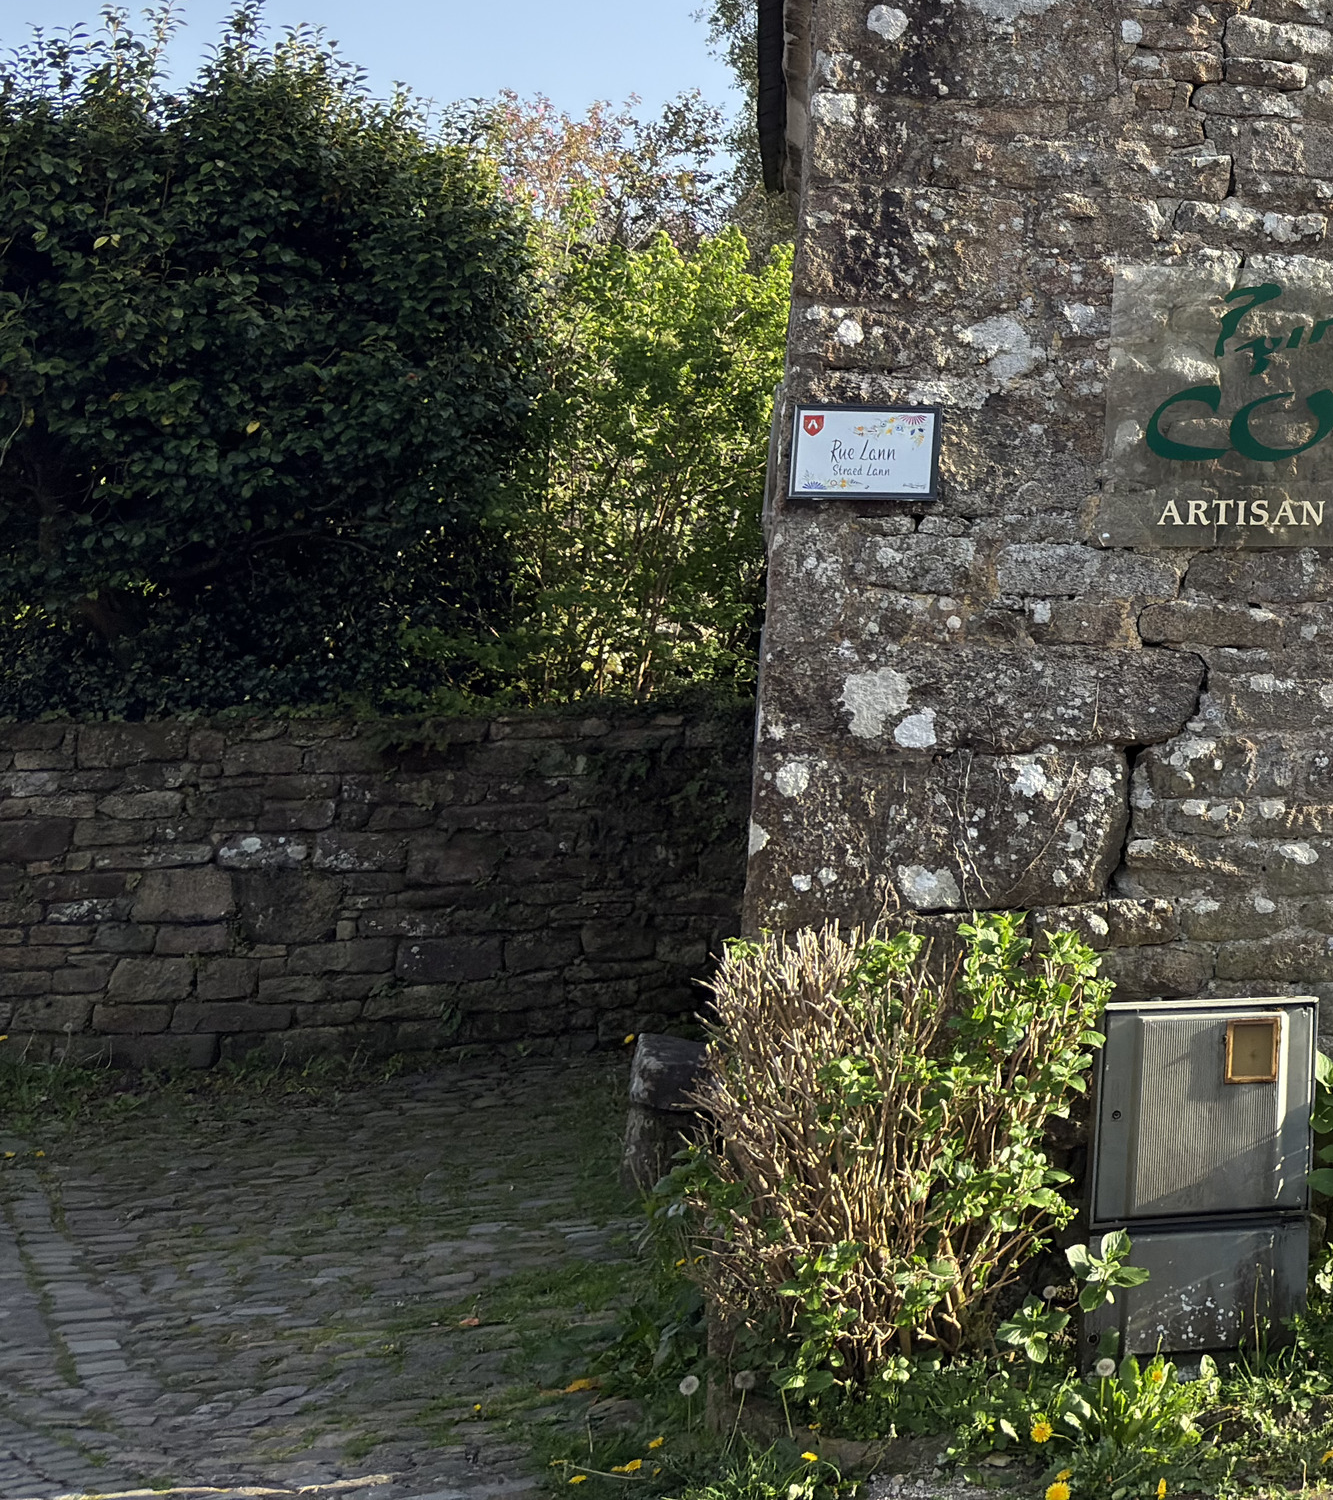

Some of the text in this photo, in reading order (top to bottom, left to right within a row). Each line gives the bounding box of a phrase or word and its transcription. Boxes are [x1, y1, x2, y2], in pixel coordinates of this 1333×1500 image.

[830, 439, 896, 463] Rue Lann
[832, 464, 890, 476] Straed Lann
[1157, 500, 1325, 526] ARTISAN
